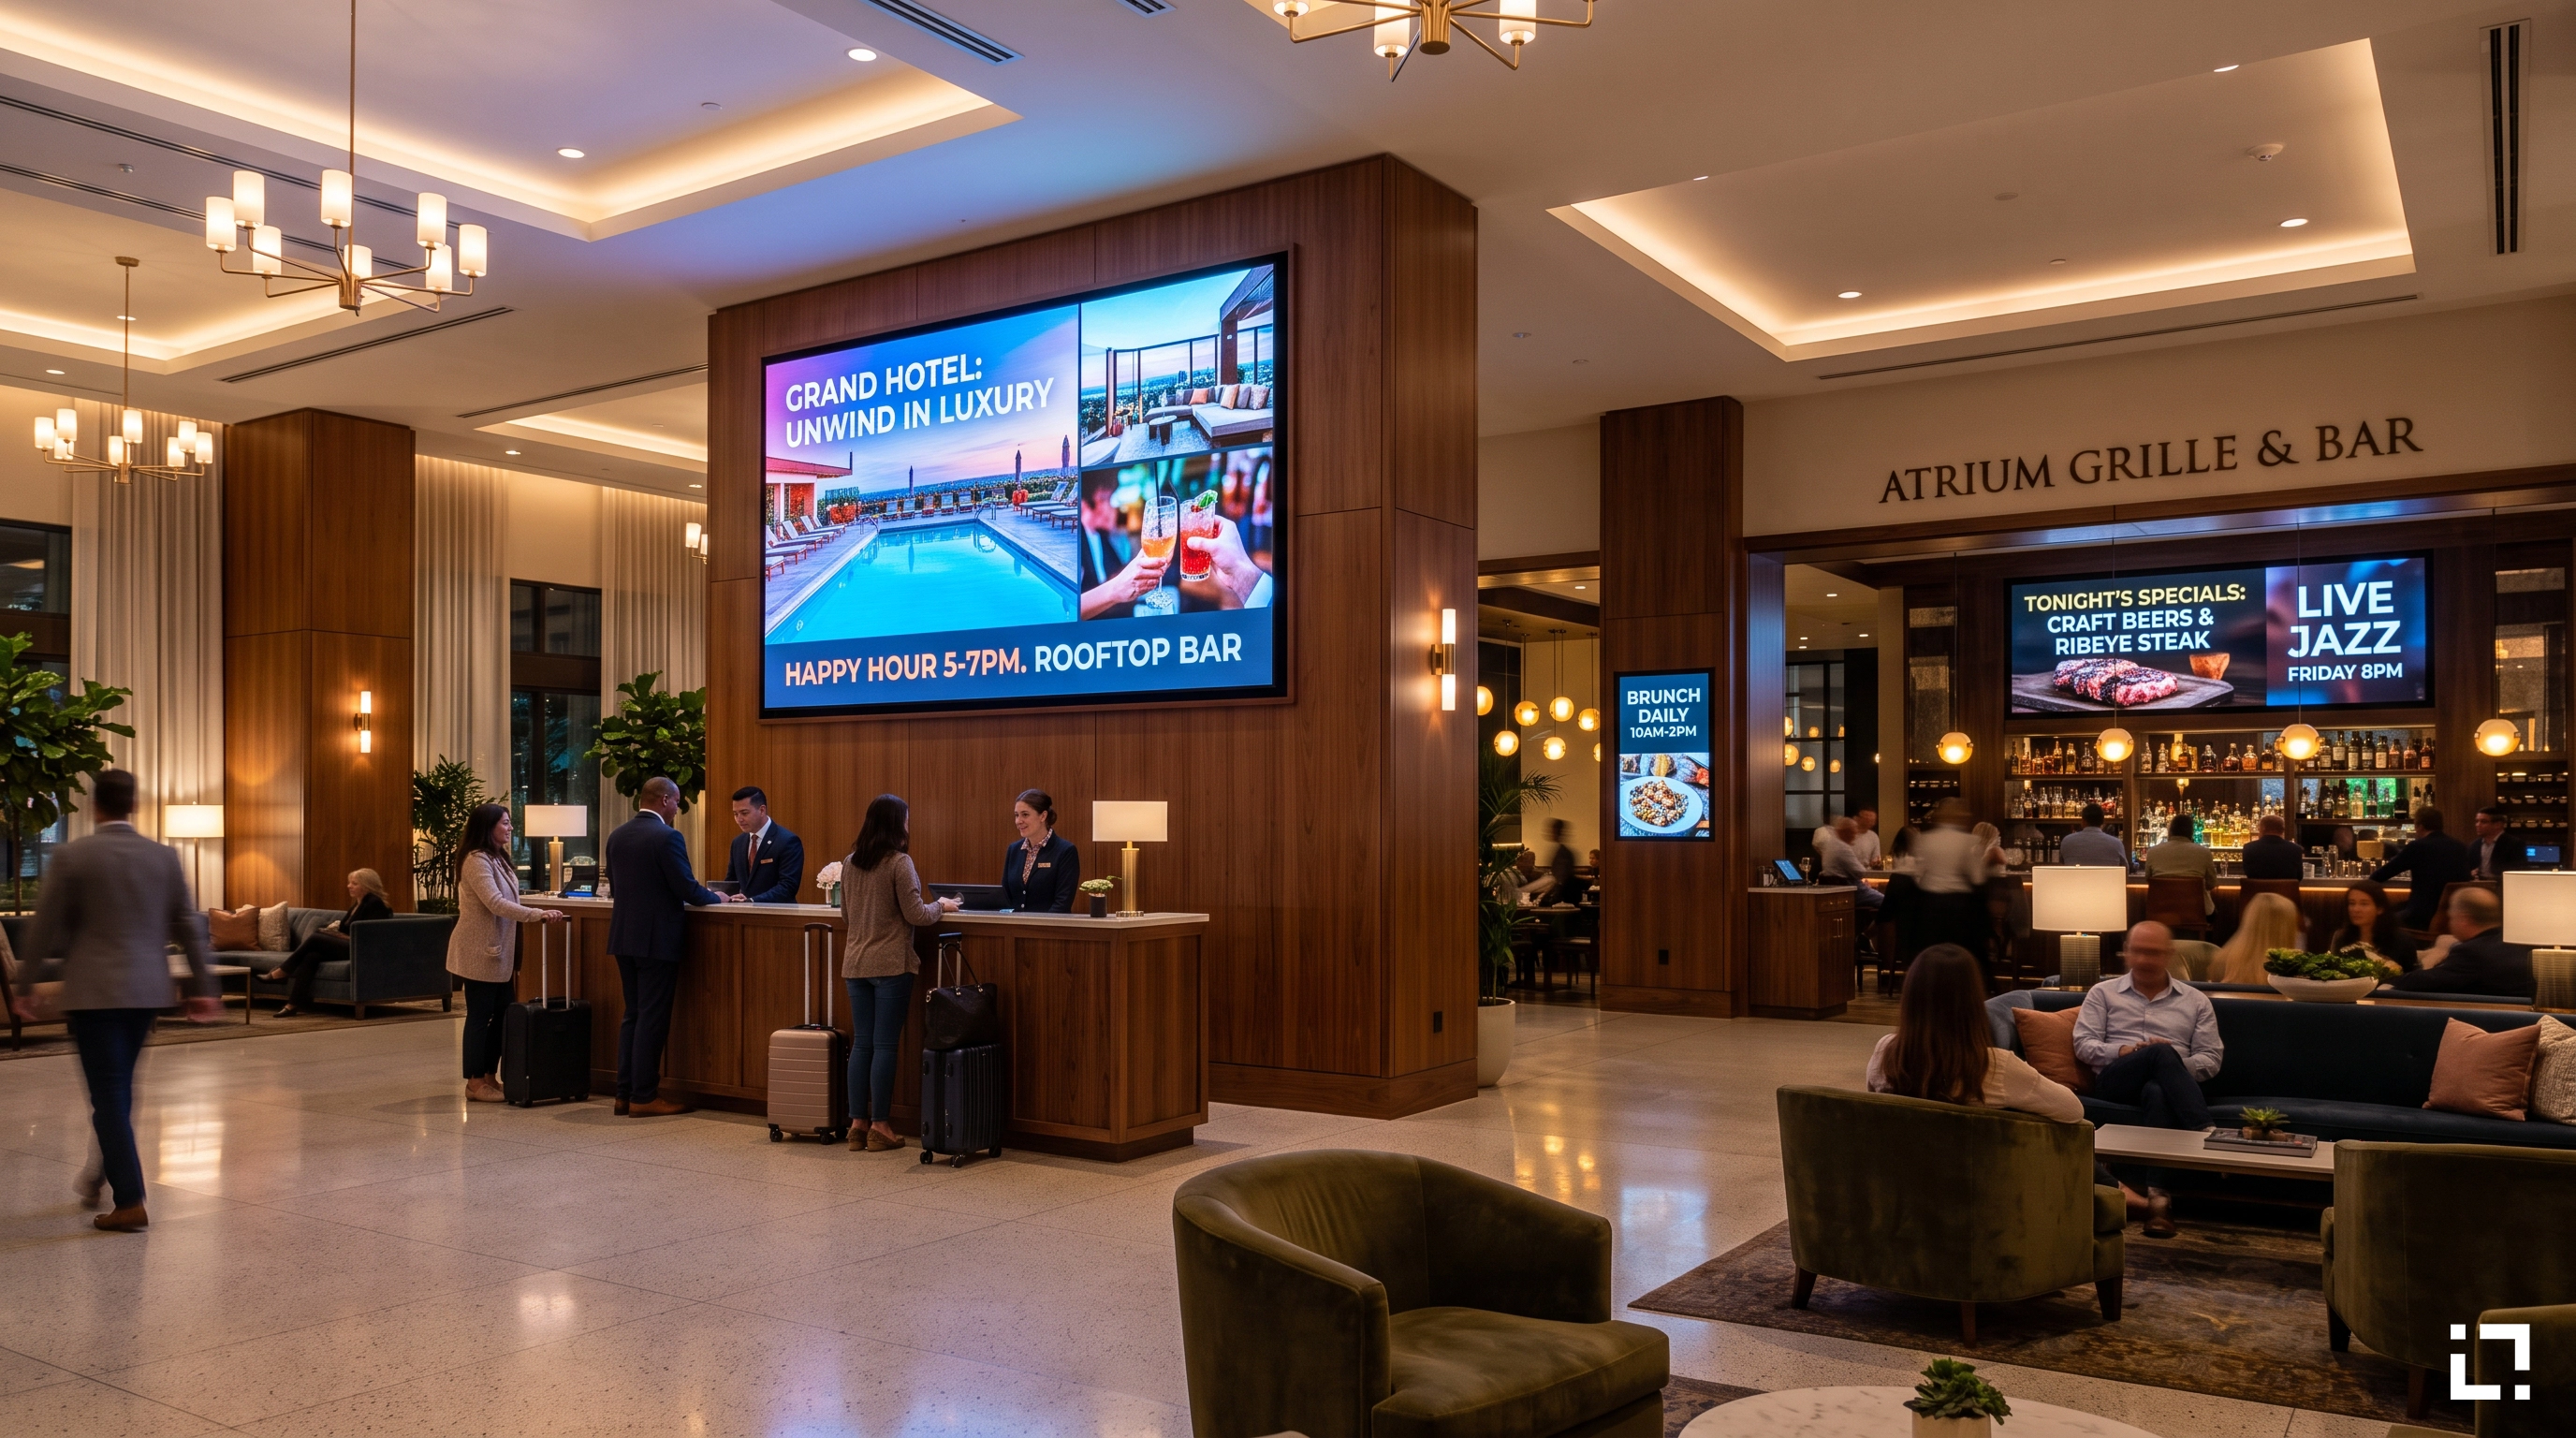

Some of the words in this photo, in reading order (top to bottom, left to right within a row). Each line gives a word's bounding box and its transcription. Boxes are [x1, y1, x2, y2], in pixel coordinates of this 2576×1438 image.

[785, 370, 878, 413] GRAND
[886, 353, 983, 396] HOTEL:
[785, 404, 896, 448] UNWIND
[903, 399, 930, 430] IN
[939, 377, 1054, 424] LUXURY
[1878, 454, 2056, 504] ATRIUM
[2069, 435, 2238, 484] GRILLE
[2257, 429, 2299, 467] &
[2315, 417, 2424, 462] BAR
[2138, 583, 2247, 607] SPECIALS:
[2297, 580, 2394, 618] LIVE
[2047, 612, 2115, 634] CRAFT
[2122, 609, 2193, 630] BEERS
[2198, 608, 2215, 626] &
[2055, 633, 2132, 655] RIBEYE
[2137, 630, 2211, 651] STEAK
[2287, 620, 2402, 658] JAZZ
[784, 657, 862, 686] HAPPY
[867, 653, 937, 682] HOUR
[943, 647, 1028, 679] 5-7PM.
[1034, 638, 1171, 673] ROOFTOP
[1178, 632, 1243, 665] BAR
[2288, 664, 2357, 682] FRIDAY
[2361, 662, 2404, 680] 8PM
[1627, 687, 1701, 705] BRUNCH
[1638, 708, 1690, 724] DAILY
[1630, 725, 1697, 738] 10AM-2PM
